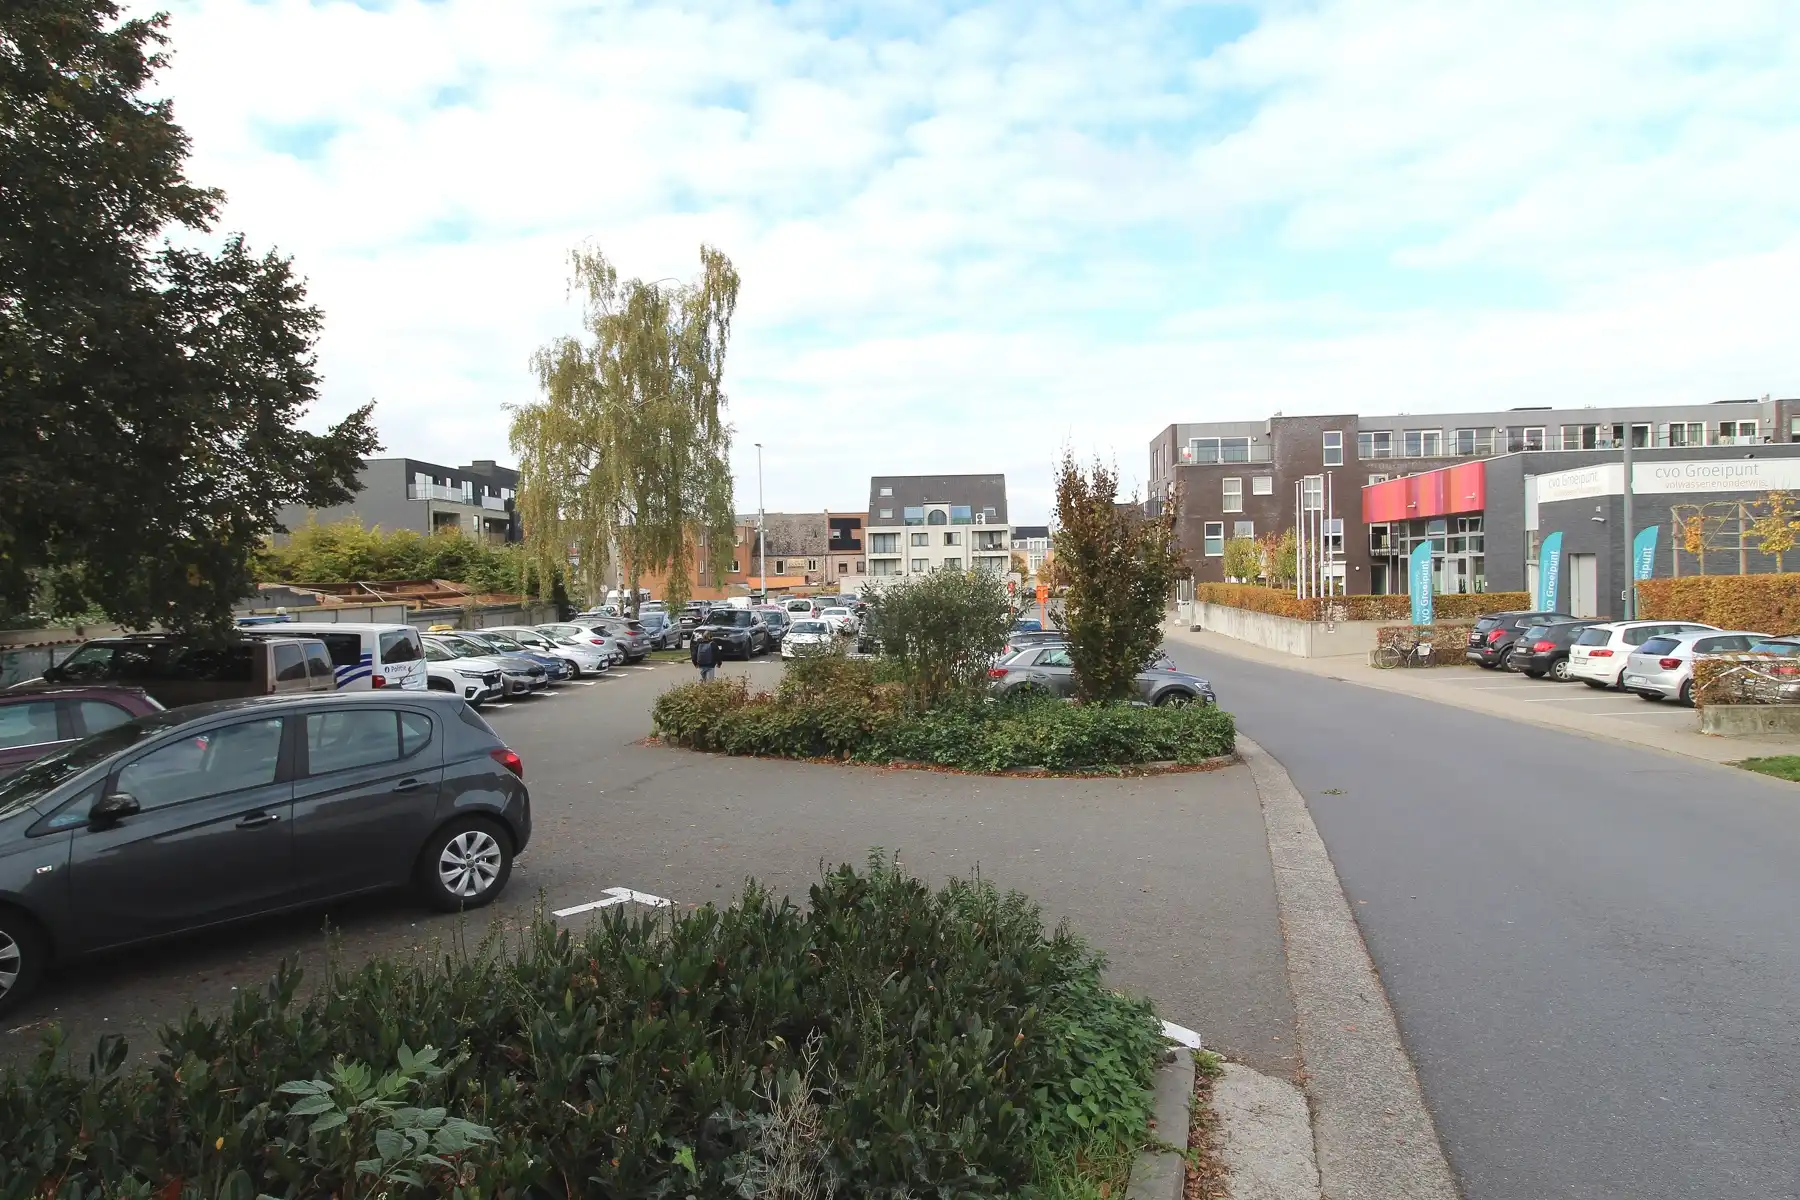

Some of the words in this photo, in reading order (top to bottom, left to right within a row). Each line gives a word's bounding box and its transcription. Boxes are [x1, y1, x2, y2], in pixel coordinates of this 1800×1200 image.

[1548, 476, 1561, 489] cvo
[1561, 470, 1598, 489] Groeipunt
[1655, 467, 1681, 479] cvo
[1685, 463, 1759, 480] Groeipunt
[1546, 551, 1560, 597] Groeipunt
[1640, 547, 1653, 580] eipunt
[1420, 559, 1431, 606] Groeipunt
